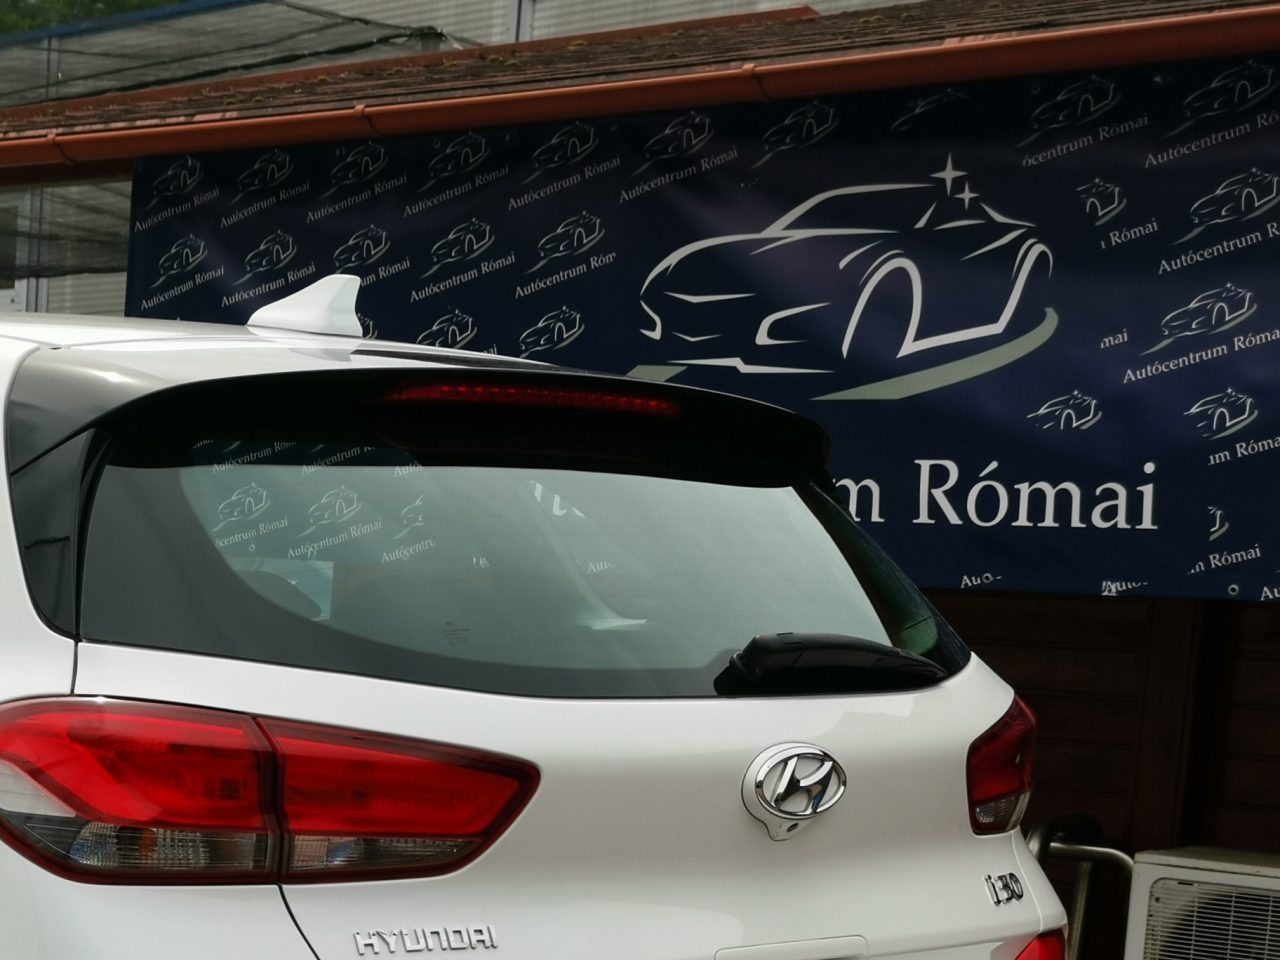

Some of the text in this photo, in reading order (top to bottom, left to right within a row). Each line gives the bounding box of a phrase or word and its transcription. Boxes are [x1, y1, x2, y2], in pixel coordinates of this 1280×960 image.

[1099, 113, 1149, 141] Római
[1144, 123, 1251, 168] Autócentrum
[403, 164, 509, 217] Autócentrum Római
[508, 156, 620, 211] Autócentrum Római
[619, 145, 738, 203] Autócentrum Római
[134, 187, 220, 232] Autócentrum Római
[220, 181, 310, 229] Autócentrum Római
[306, 175, 408, 224] Autócentrum Római
[1110, 217, 1158, 246] Római
[1158, 230, 1262, 275] Autócentrum
[140, 265, 224, 311] Autócentrum Római
[221, 261, 316, 308] Autócentrum Római
[378, 256, 411, 279] Római
[410, 267, 478, 303] Autócentrum
[480, 251, 516, 274] Római
[515, 264, 587, 299] Autócentrum
[1122, 342, 1228, 384] Autócentrum
[912, 458, 1160, 530] Római
[258, 515, 289, 533] Római
[287, 519, 383, 559] Autócentrum Római
[1209, 543, 1262, 569] Római
[352, 923, 498, 956] HYUNDAI
